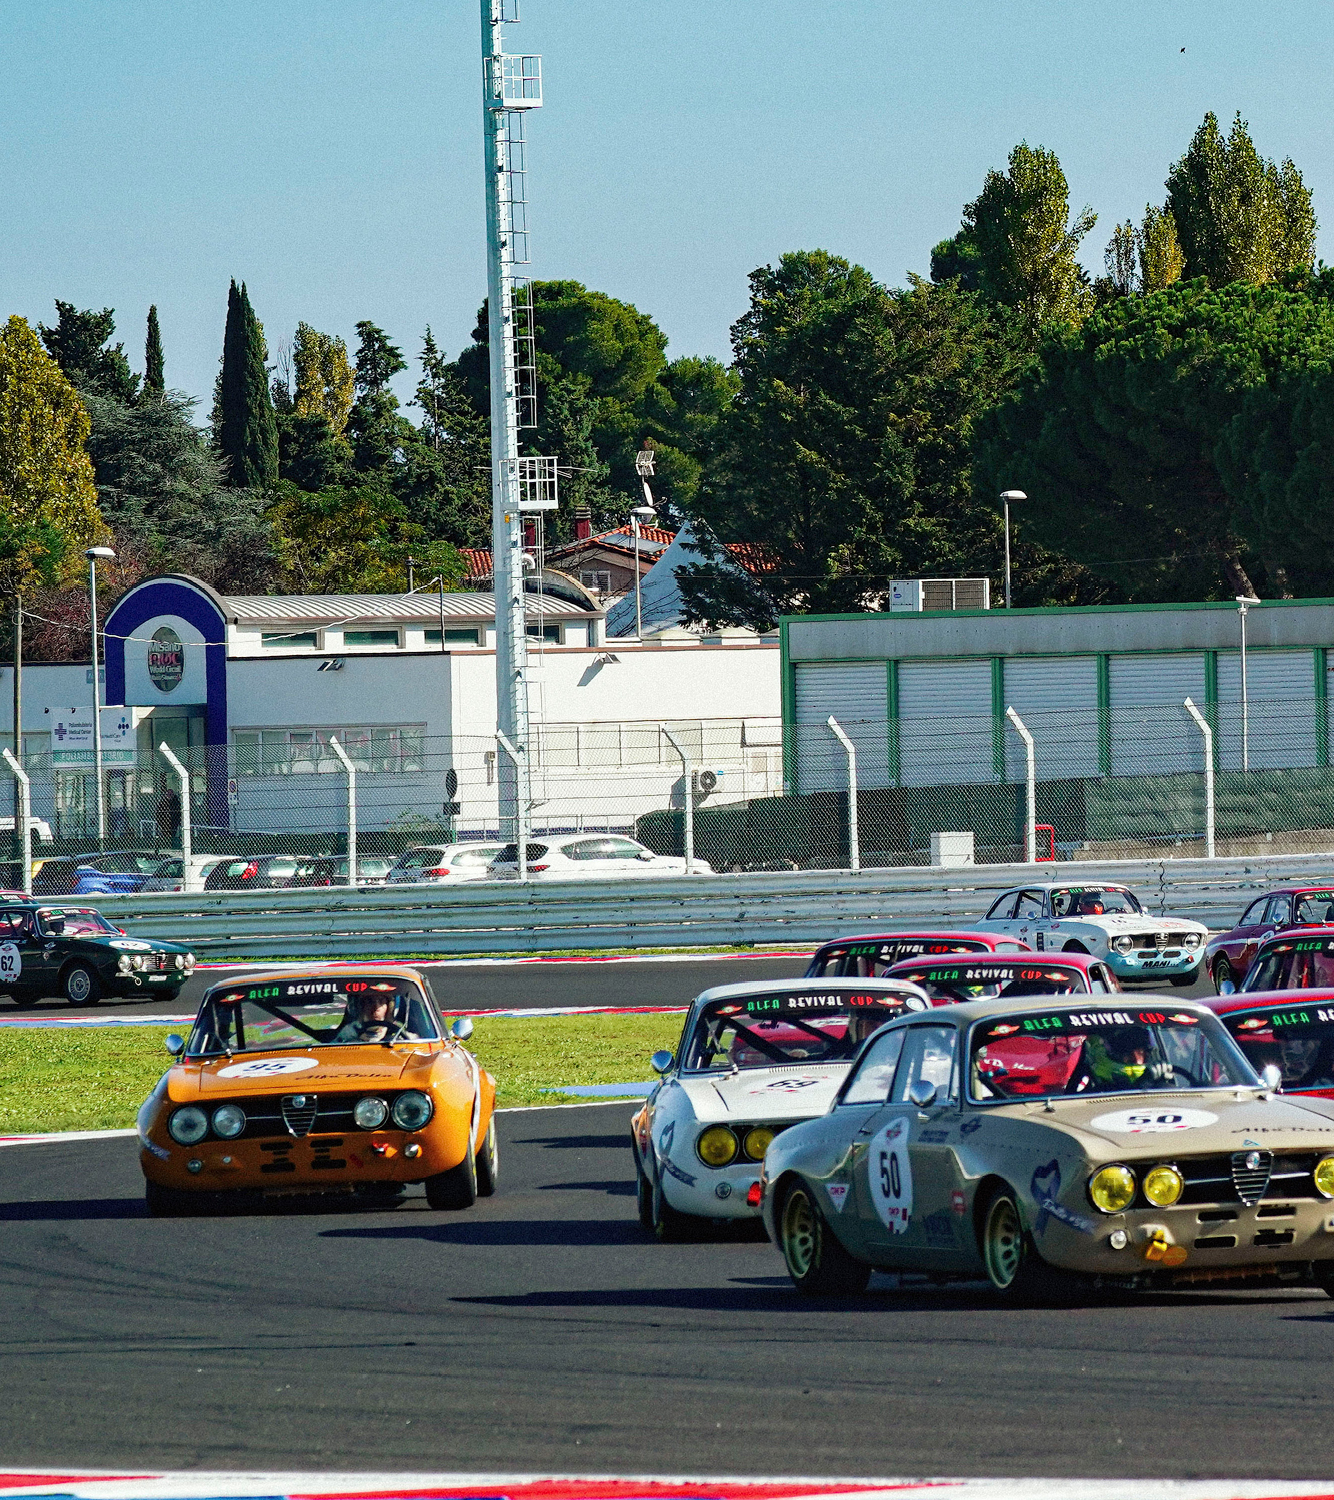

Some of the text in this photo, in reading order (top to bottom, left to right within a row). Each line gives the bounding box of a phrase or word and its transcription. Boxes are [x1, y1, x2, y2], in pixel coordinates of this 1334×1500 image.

[849, 946, 876, 955] ALFA
[880, 944, 925, 954] REVIVAL
[1296, 942, 1323, 951] ALFA
[1, 955, 14, 971] 62
[928, 968, 1042, 981] ALFA REVIVAL CUP
[249, 982, 368, 999] ALFA REVIVAL CUP
[747, 995, 874, 1011] ALFA REVIVAL CUP
[1023, 1012, 1166, 1031] ALFA REVIVAL CUP
[1272, 1012, 1310, 1027] ALFA
[1127, 1115, 1182, 1125] 50
[879, 1151, 901, 1199] 50
